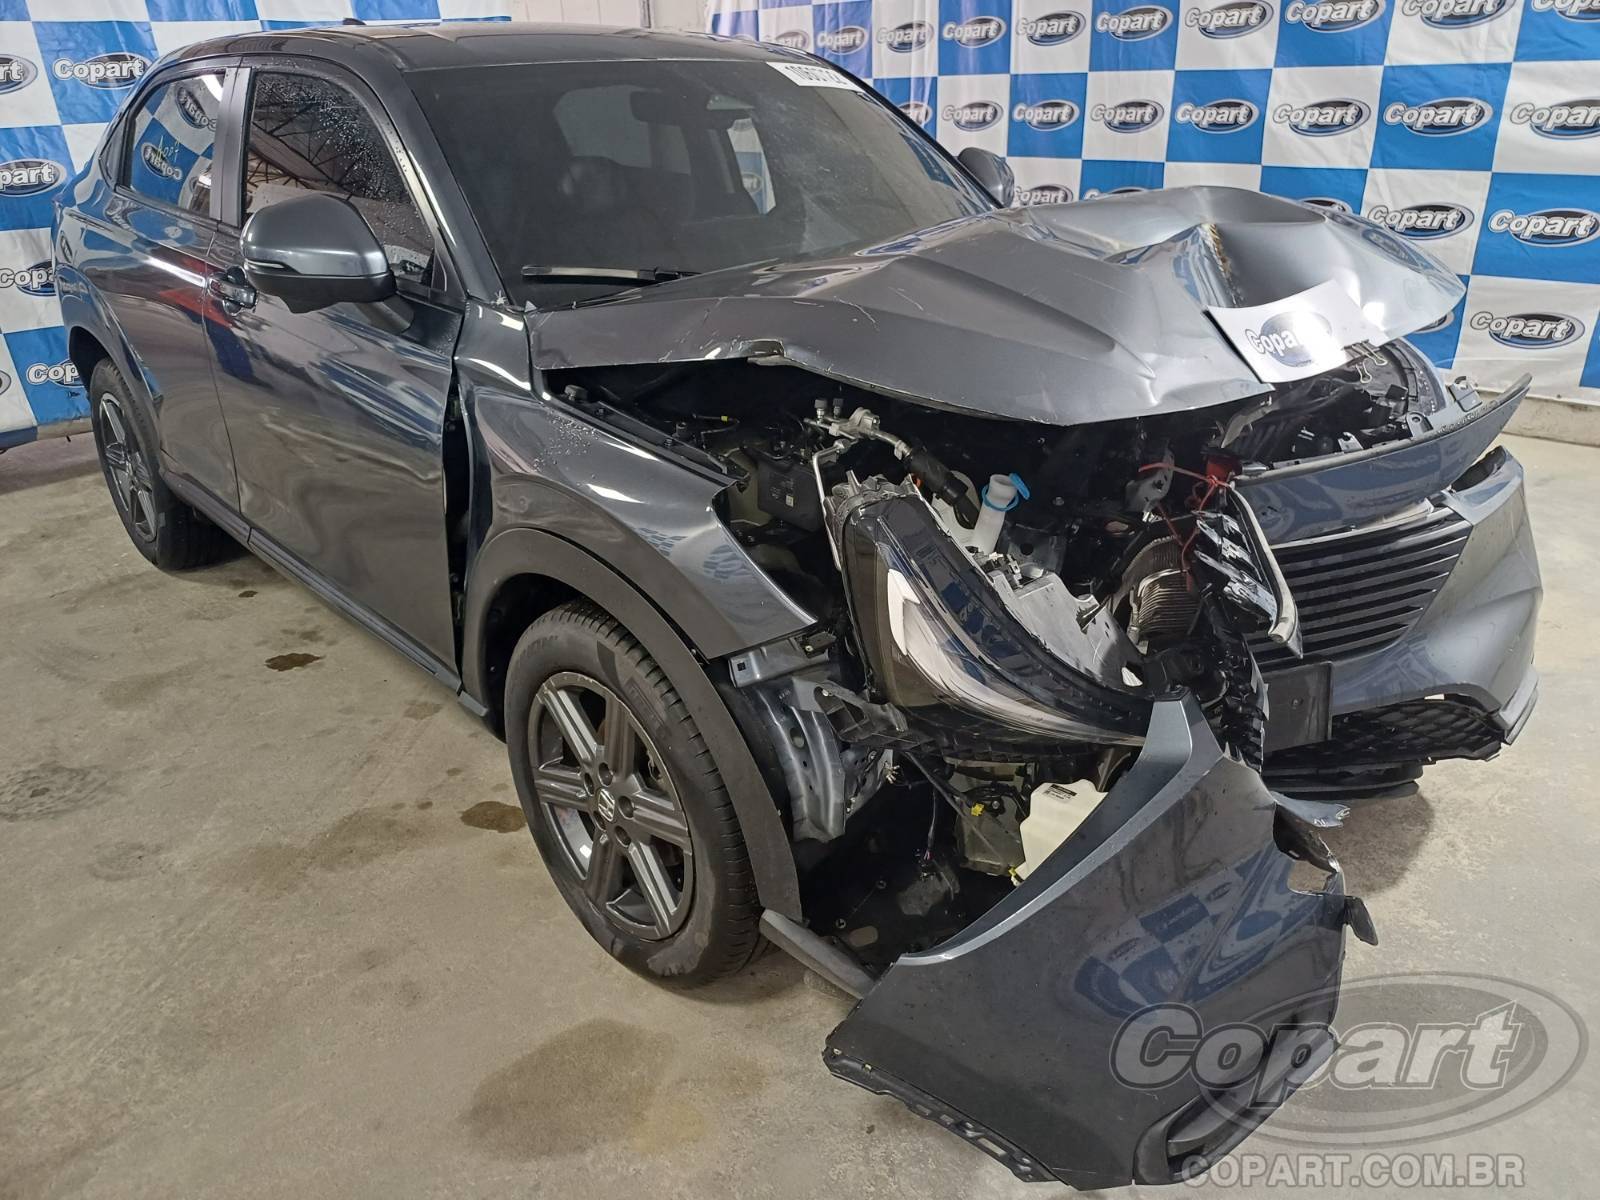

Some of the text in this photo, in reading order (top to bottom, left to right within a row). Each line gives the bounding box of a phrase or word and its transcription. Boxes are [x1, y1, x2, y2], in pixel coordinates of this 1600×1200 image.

[1097, 11, 1162, 35] Copart
[1184, 5, 1264, 33] Copart
[1285, 0, 1374, 22] Copart
[817, 28, 863, 47] Copart
[878, 26, 927, 44] Copart
[944, 20, 999, 42] Copart
[1017, 16, 1076, 38] Copart
[54, 59, 144, 83] Copart
[942, 103, 996, 126] Copart
[1013, 103, 1072, 124] Copart
[1091, 103, 1156, 125] Copart
[1176, 103, 1250, 127] Copart
[1272, 102, 1359, 129] Copart
[1385, 103, 1478, 128] Copart
[1510, 102, 1600, 131] Copar
[0, 163, 53, 191] part
[1367, 204, 1461, 231] Copart
[1488, 208, 1597, 240] Copart
[0, 268, 54, 290] Cop
[1470, 311, 1572, 340] Copart
[1245, 328, 1300, 357] Copa
[26, 363, 80, 385] Cop
